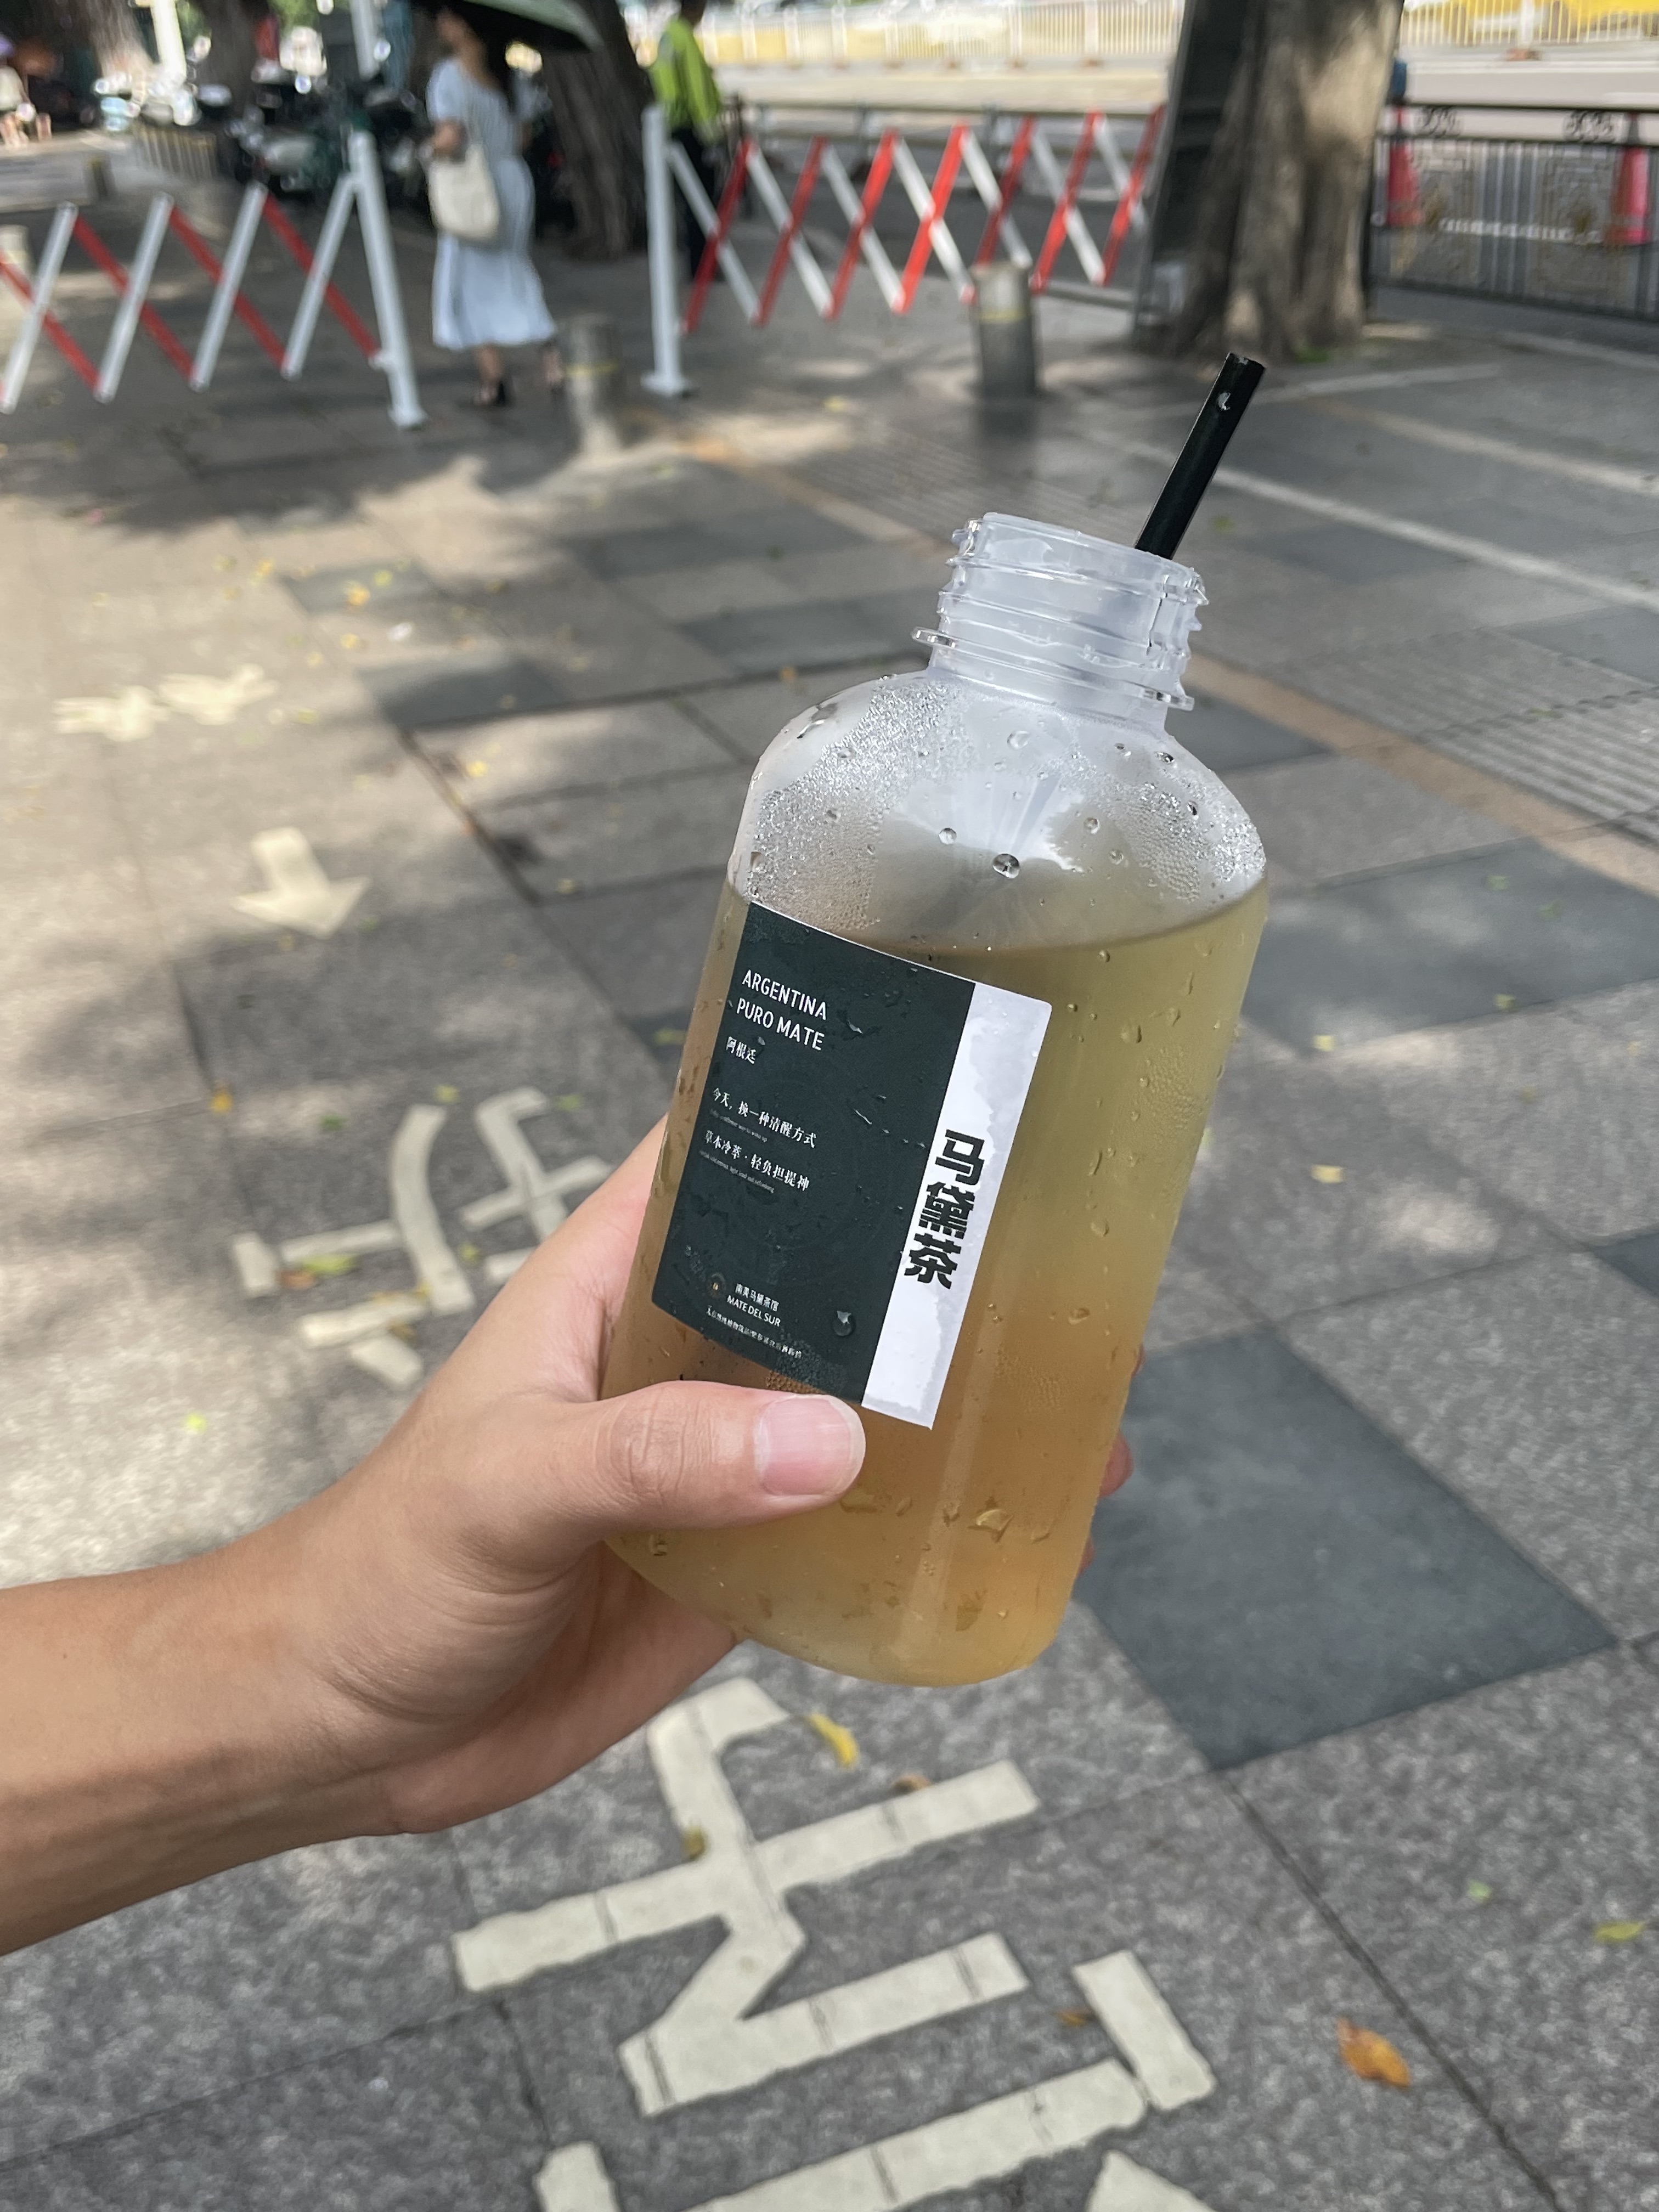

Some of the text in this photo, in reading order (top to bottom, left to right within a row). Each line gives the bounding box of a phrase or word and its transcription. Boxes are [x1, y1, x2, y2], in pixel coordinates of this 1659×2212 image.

[742, 969, 827, 1021] ARGENTINA
[725, 1036, 757, 1064] 阿根廷
[736, 997, 825, 1051] PURO MATE
[904, 1128, 985, 1290] 马黛茶
[726, 1294, 781, 1327] MATE DEL SUR
